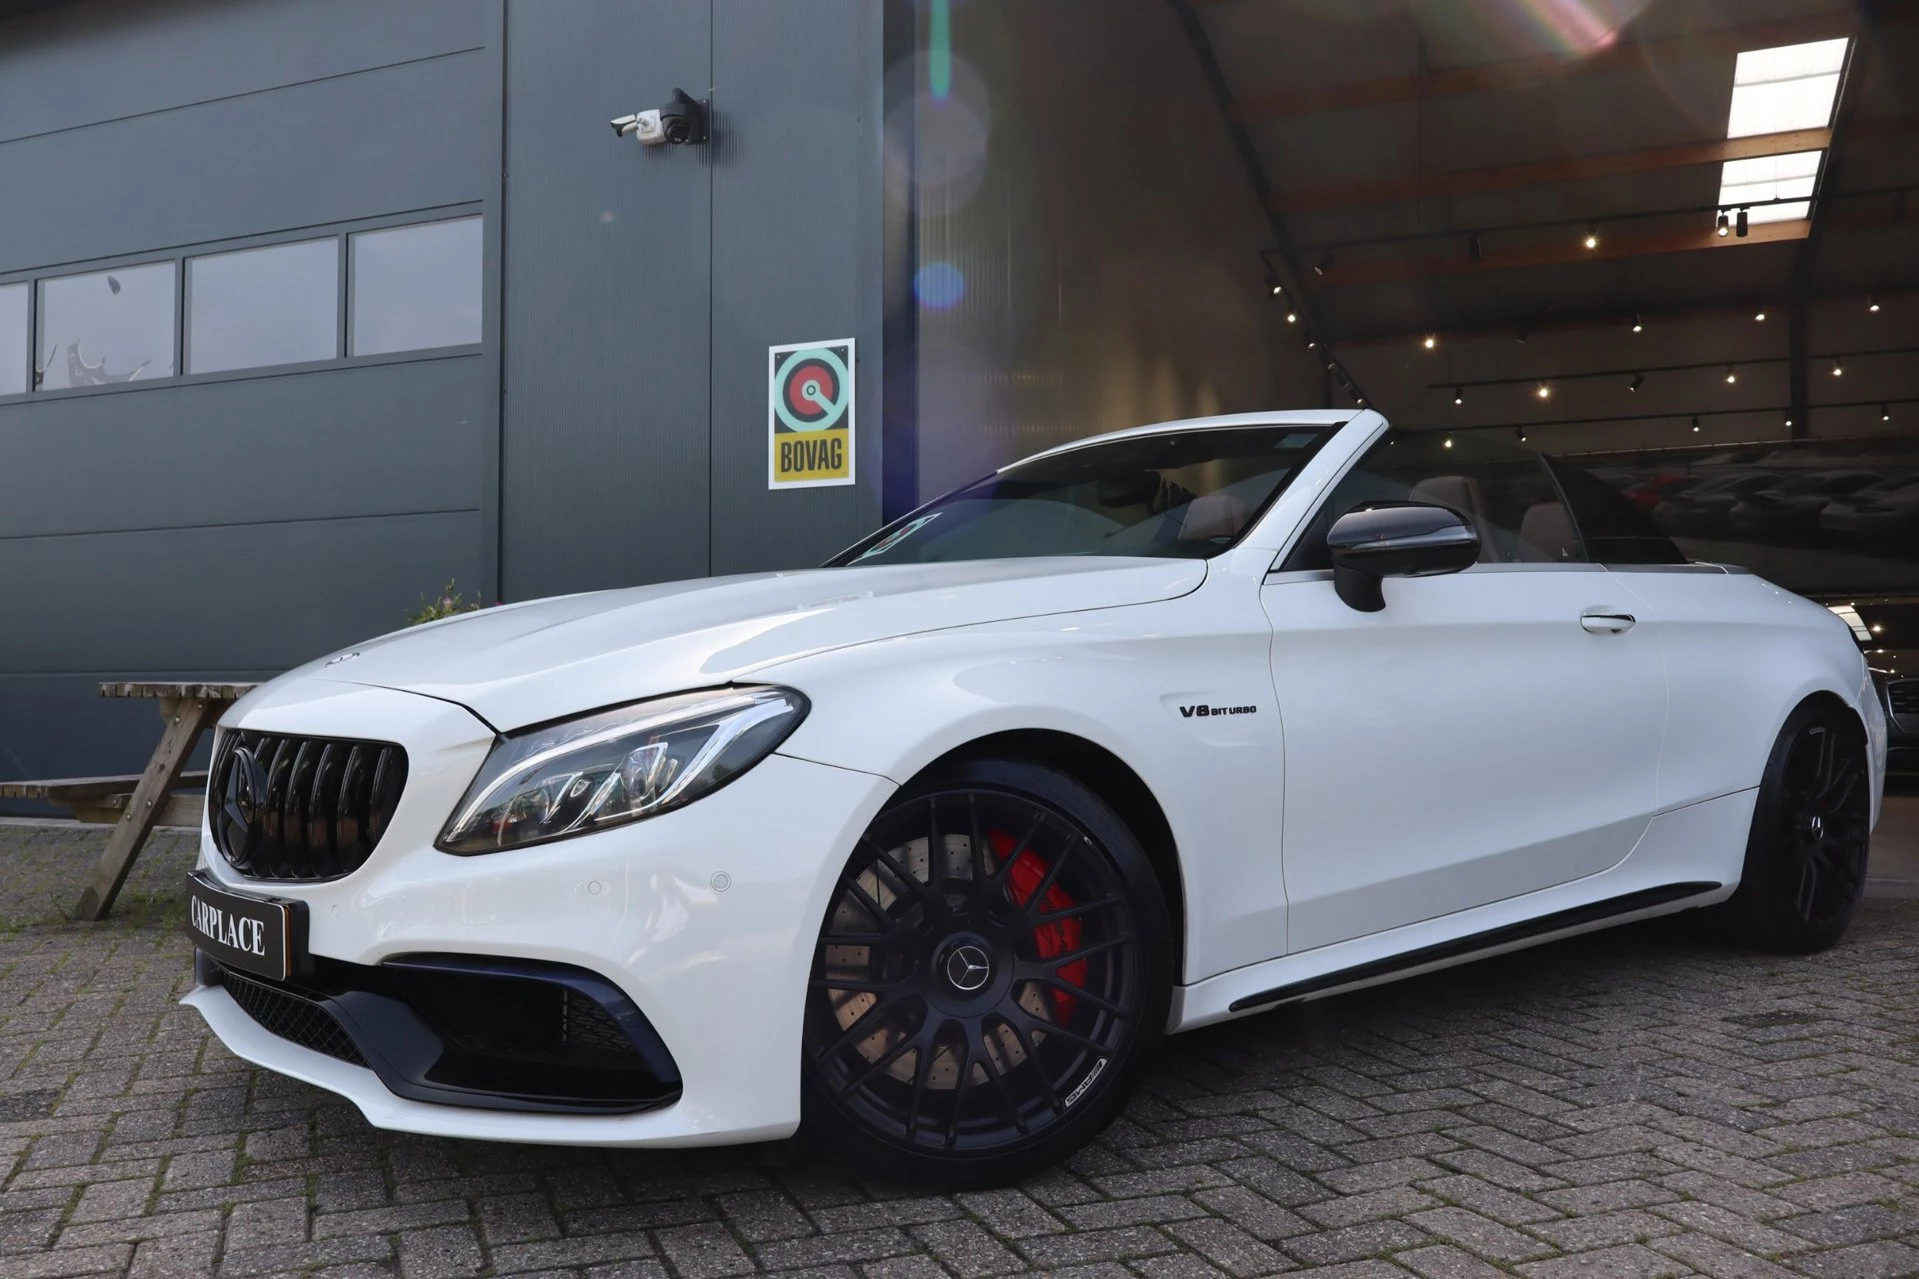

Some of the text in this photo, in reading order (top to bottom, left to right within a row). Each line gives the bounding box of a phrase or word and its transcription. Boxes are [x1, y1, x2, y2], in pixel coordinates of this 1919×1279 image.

[780, 437, 842, 473] BOVAG
[1179, 704, 1257, 718] V8 BITURBO
[191, 895, 266, 956] CARPLACE
